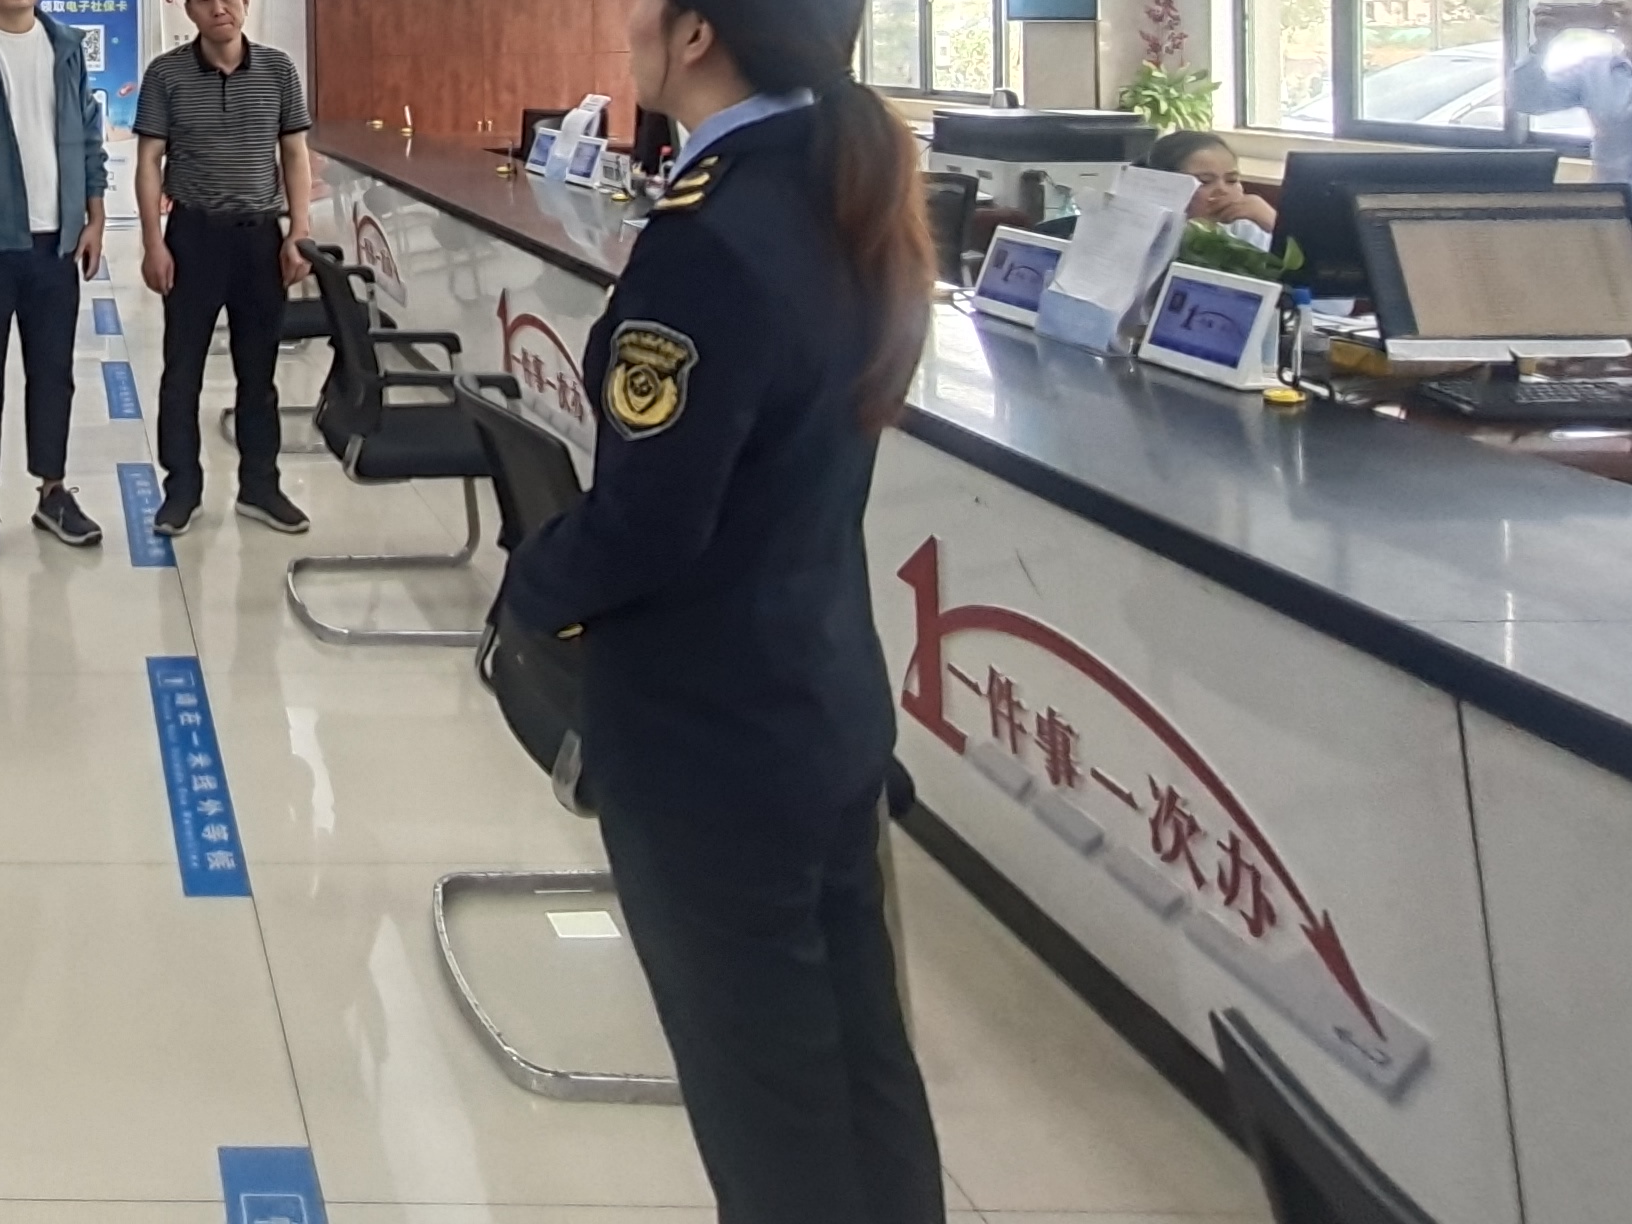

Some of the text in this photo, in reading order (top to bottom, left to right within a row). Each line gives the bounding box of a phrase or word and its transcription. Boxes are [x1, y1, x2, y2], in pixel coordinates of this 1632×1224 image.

[40, 0, 128, 14] 领取电子社保卡
[946, 662, 1278, 939] 一件事一次办
